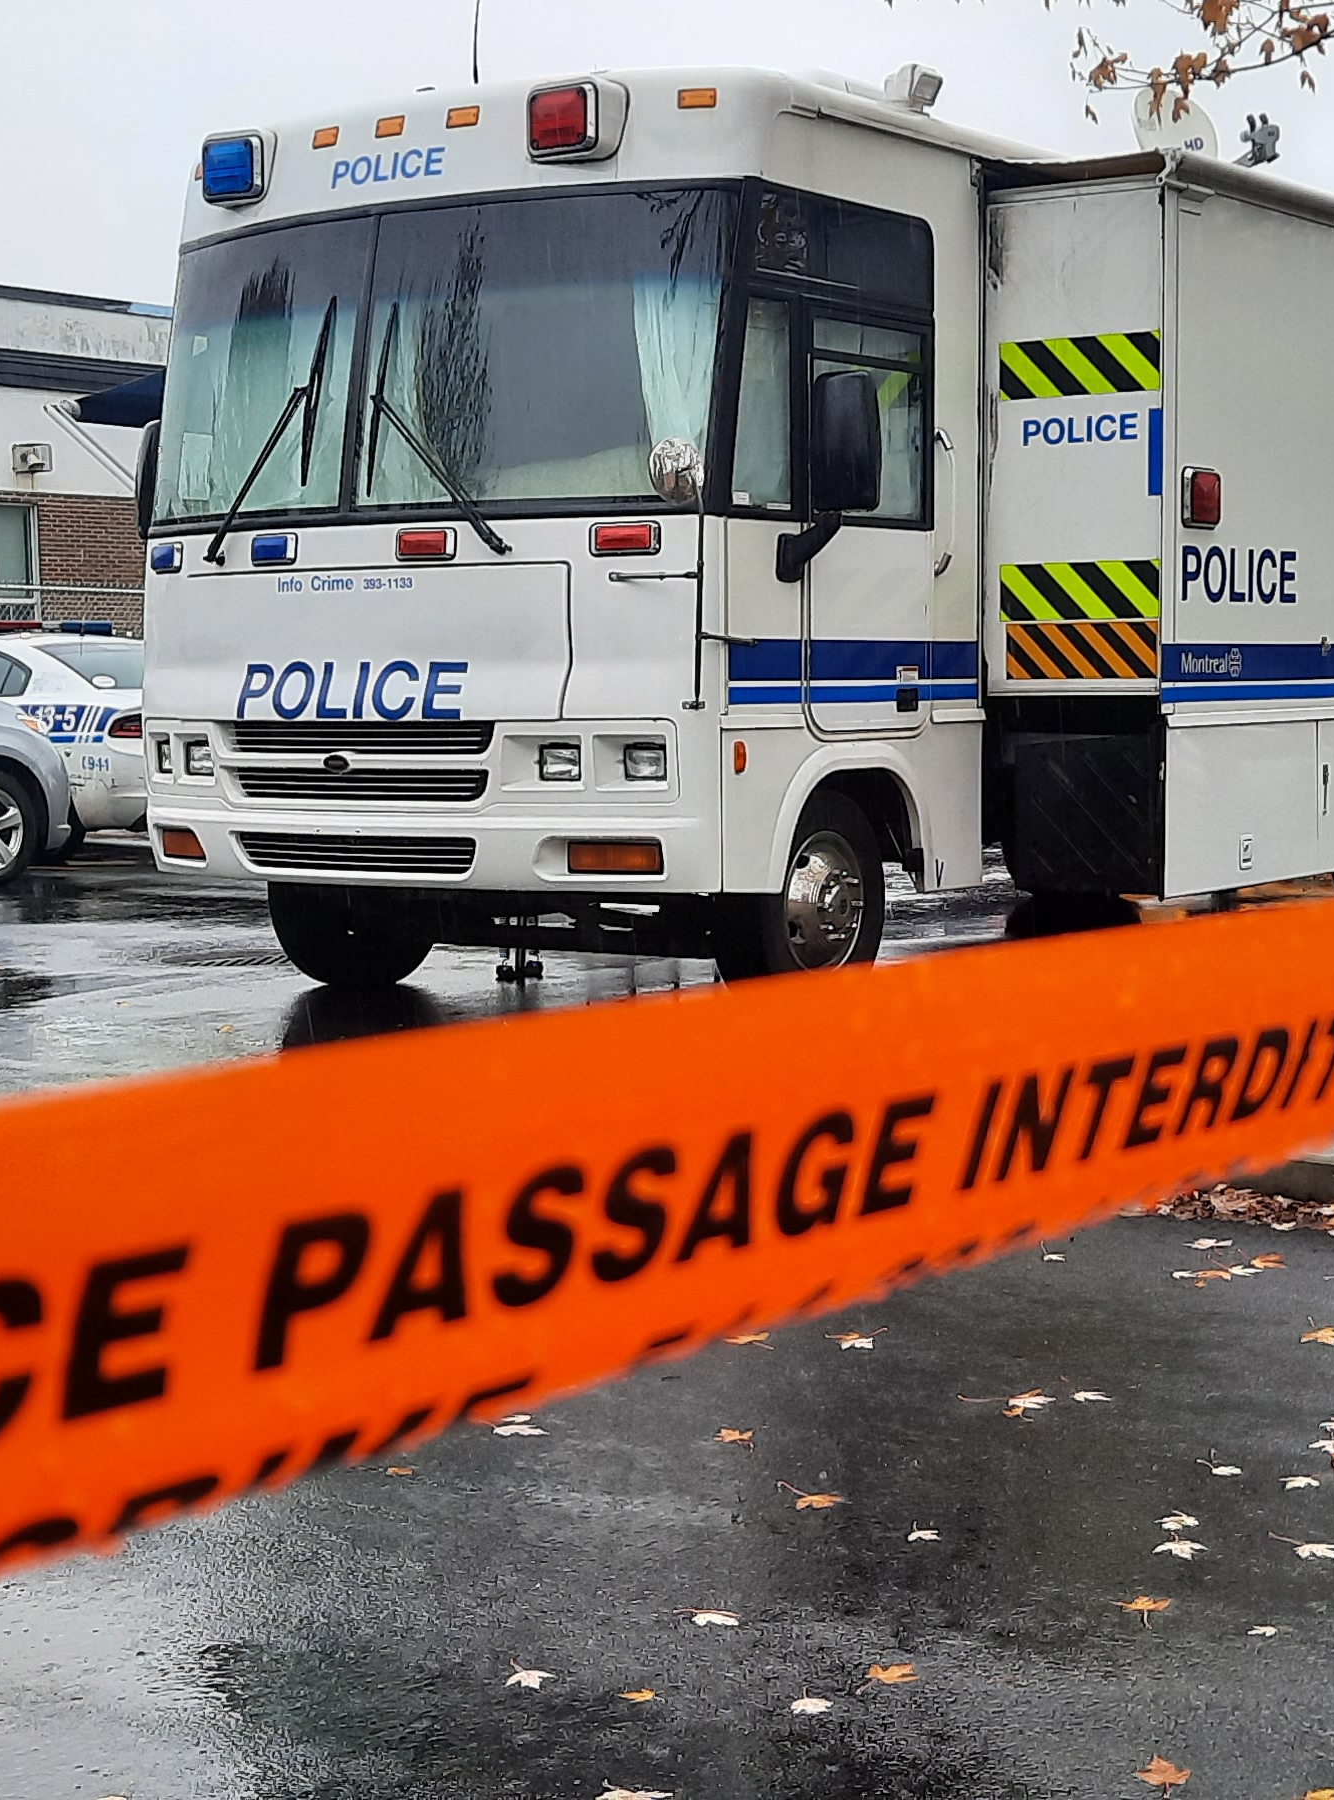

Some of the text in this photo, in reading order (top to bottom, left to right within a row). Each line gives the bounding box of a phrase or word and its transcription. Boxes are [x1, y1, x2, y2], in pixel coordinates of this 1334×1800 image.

[1184, 137, 1204, 151] HD
[331, 146, 446, 190] POLICE
[1023, 412, 1138, 447] POLICE
[277, 575, 413, 593] Info Crime 393-1133
[1181, 545, 1297, 604] POLICE
[236, 660, 469, 720] POLICE
[252, 1095, 934, 1371] PASSAGE
